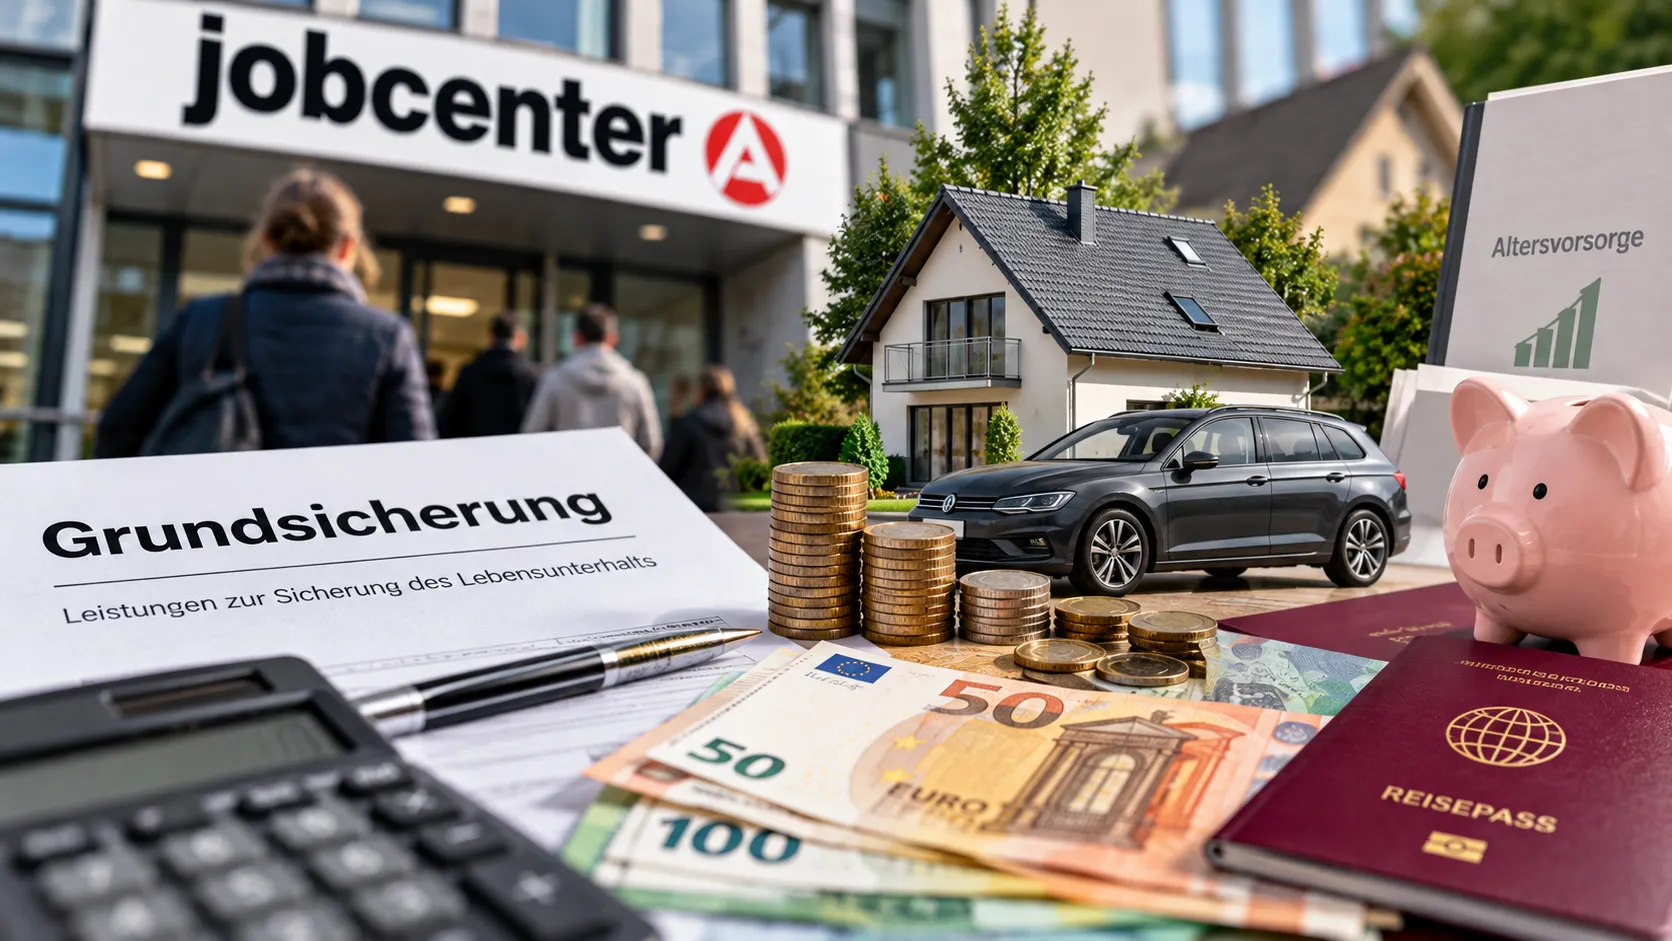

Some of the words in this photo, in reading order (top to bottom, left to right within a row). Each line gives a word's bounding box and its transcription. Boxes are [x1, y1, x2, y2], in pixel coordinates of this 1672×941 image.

[182, 13, 683, 173] jobcenter
[1491, 229, 1644, 258] Altersvorsorge
[43, 491, 612, 559] Grundsicherung
[63, 597, 218, 625] Leistungen
[226, 591, 268, 611] zur
[273, 580, 403, 606] Sicherung
[409, 574, 453, 591] des
[457, 554, 658, 587] Lebensunterhalts
[923, 678, 1065, 729] 50
[688, 738, 787, 781] 50
[886, 781, 989, 816] EURO
[1381, 785, 1559, 834] REISEPASS
[659, 816, 802, 864] 100
